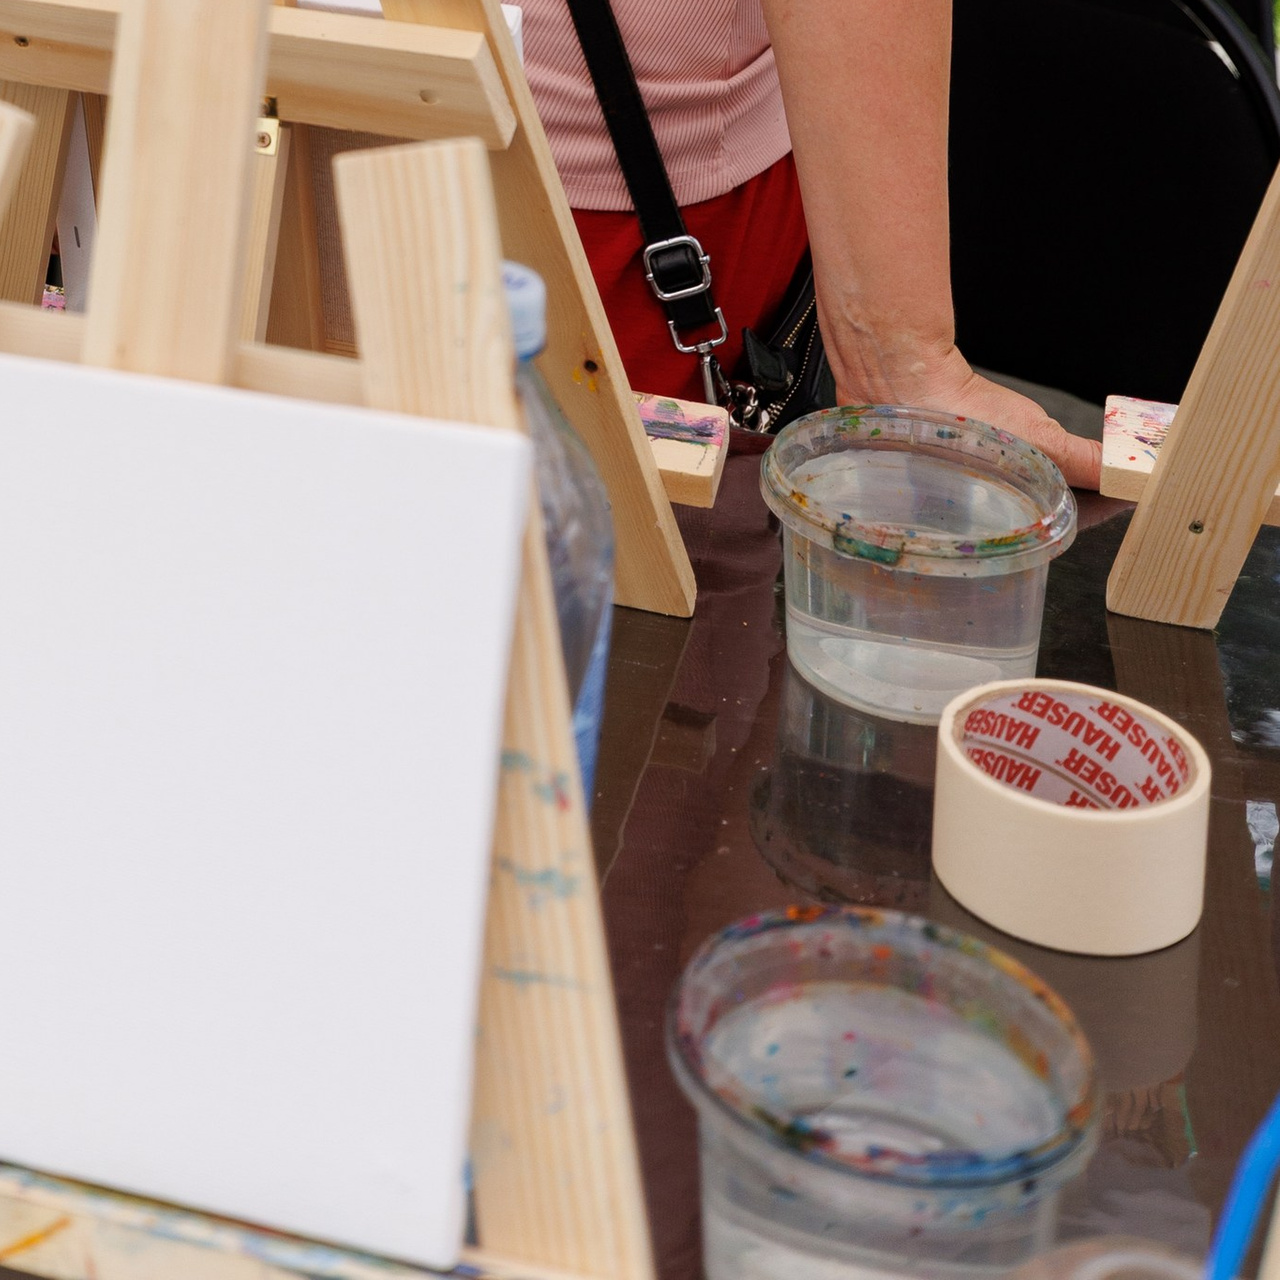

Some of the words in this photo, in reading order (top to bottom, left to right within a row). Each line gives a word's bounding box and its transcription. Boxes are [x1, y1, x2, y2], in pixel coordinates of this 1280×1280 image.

[964, 709, 1041, 750] HAUSER
[1018, 691, 1122, 762] HAUSER
[1096, 701, 1180, 796] HAUSER
[967, 747, 1042, 792] HAUSE
